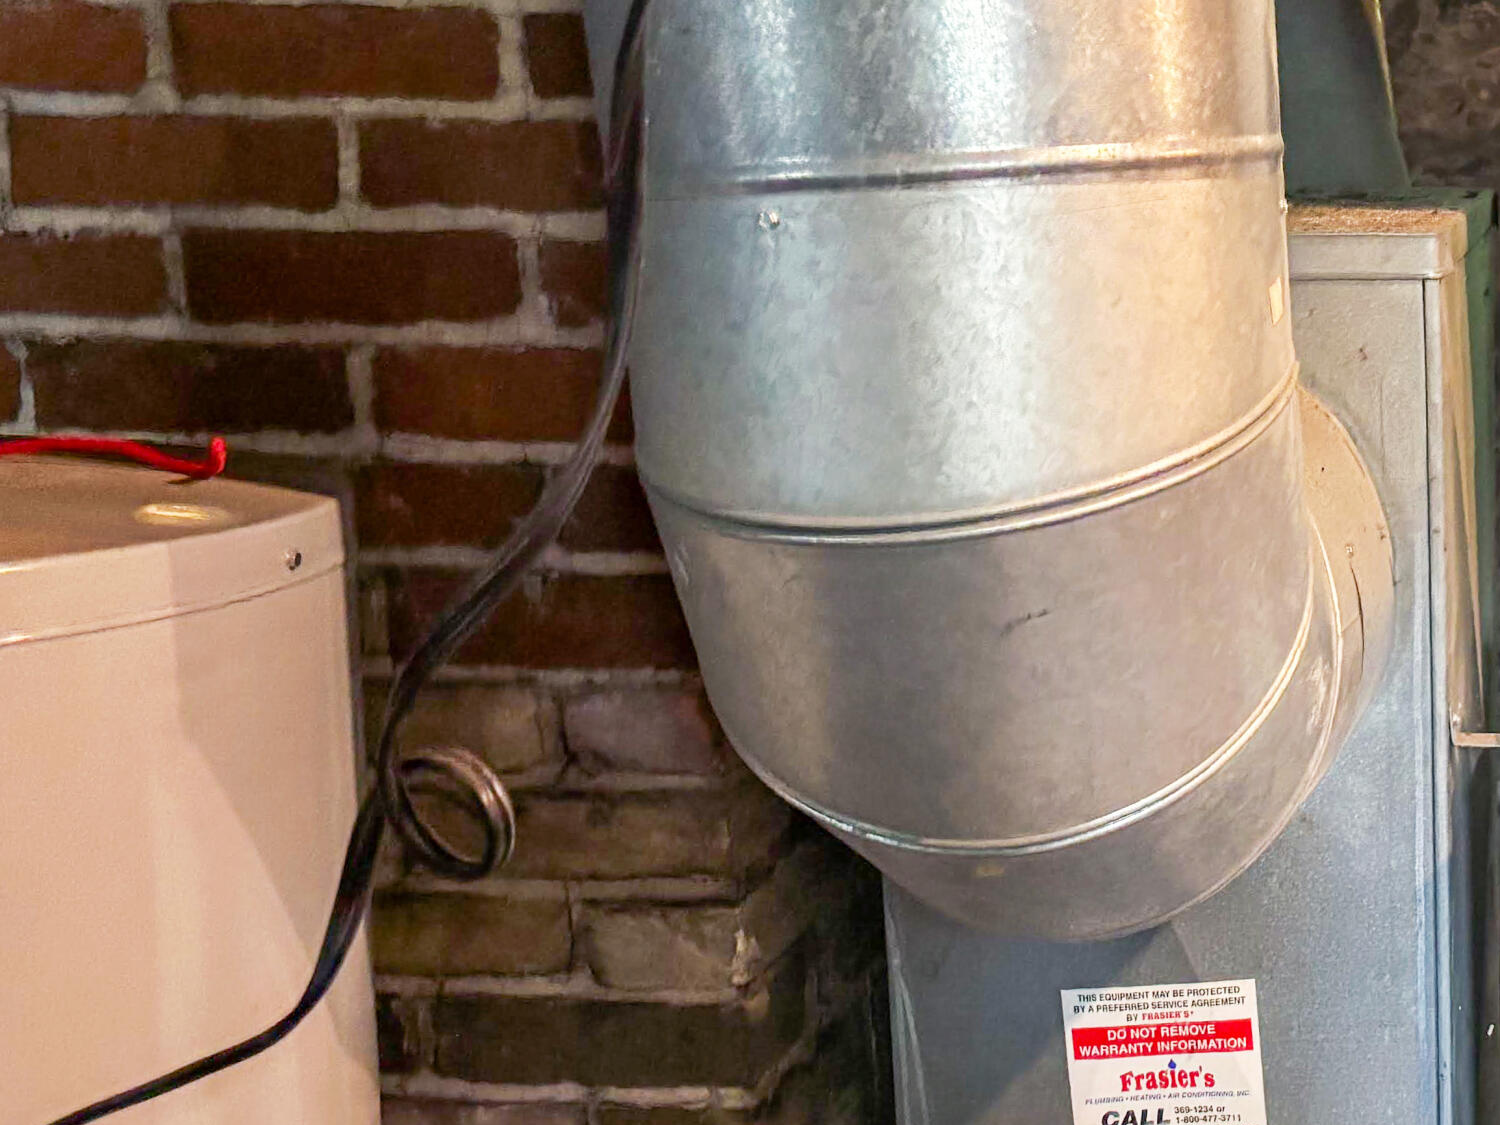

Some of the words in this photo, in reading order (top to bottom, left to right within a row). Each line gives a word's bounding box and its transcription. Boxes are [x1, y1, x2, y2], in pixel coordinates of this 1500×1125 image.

[1077, 994, 1097, 1002] THIS
[1099, 990, 1150, 1001] EQUIPMENT
[1152, 990, 1170, 998] MAY
[1172, 989, 1184, 997] BE
[1187, 986, 1240, 997] PROTECTED
[1073, 1005, 1085, 1013] BY
[1087, 1005, 1095, 1013] A
[1096, 1002, 1149, 1013] PREFERRED
[1151, 1000, 1188, 1010] SERVICE
[1191, 996, 1246, 1007] AGREEMENT
[1126, 1013, 1138, 1022] BY
[1107, 1028, 1127, 1041] DO
[1130, 1027, 1157, 1039] NOT
[1160, 1024, 1216, 1038] REMOVE
[1079, 1042, 1155, 1057] WARRANTY
[1157, 1038, 1247, 1051] INFORMATION
[1119, 1064, 1216, 1092] Frasier's
